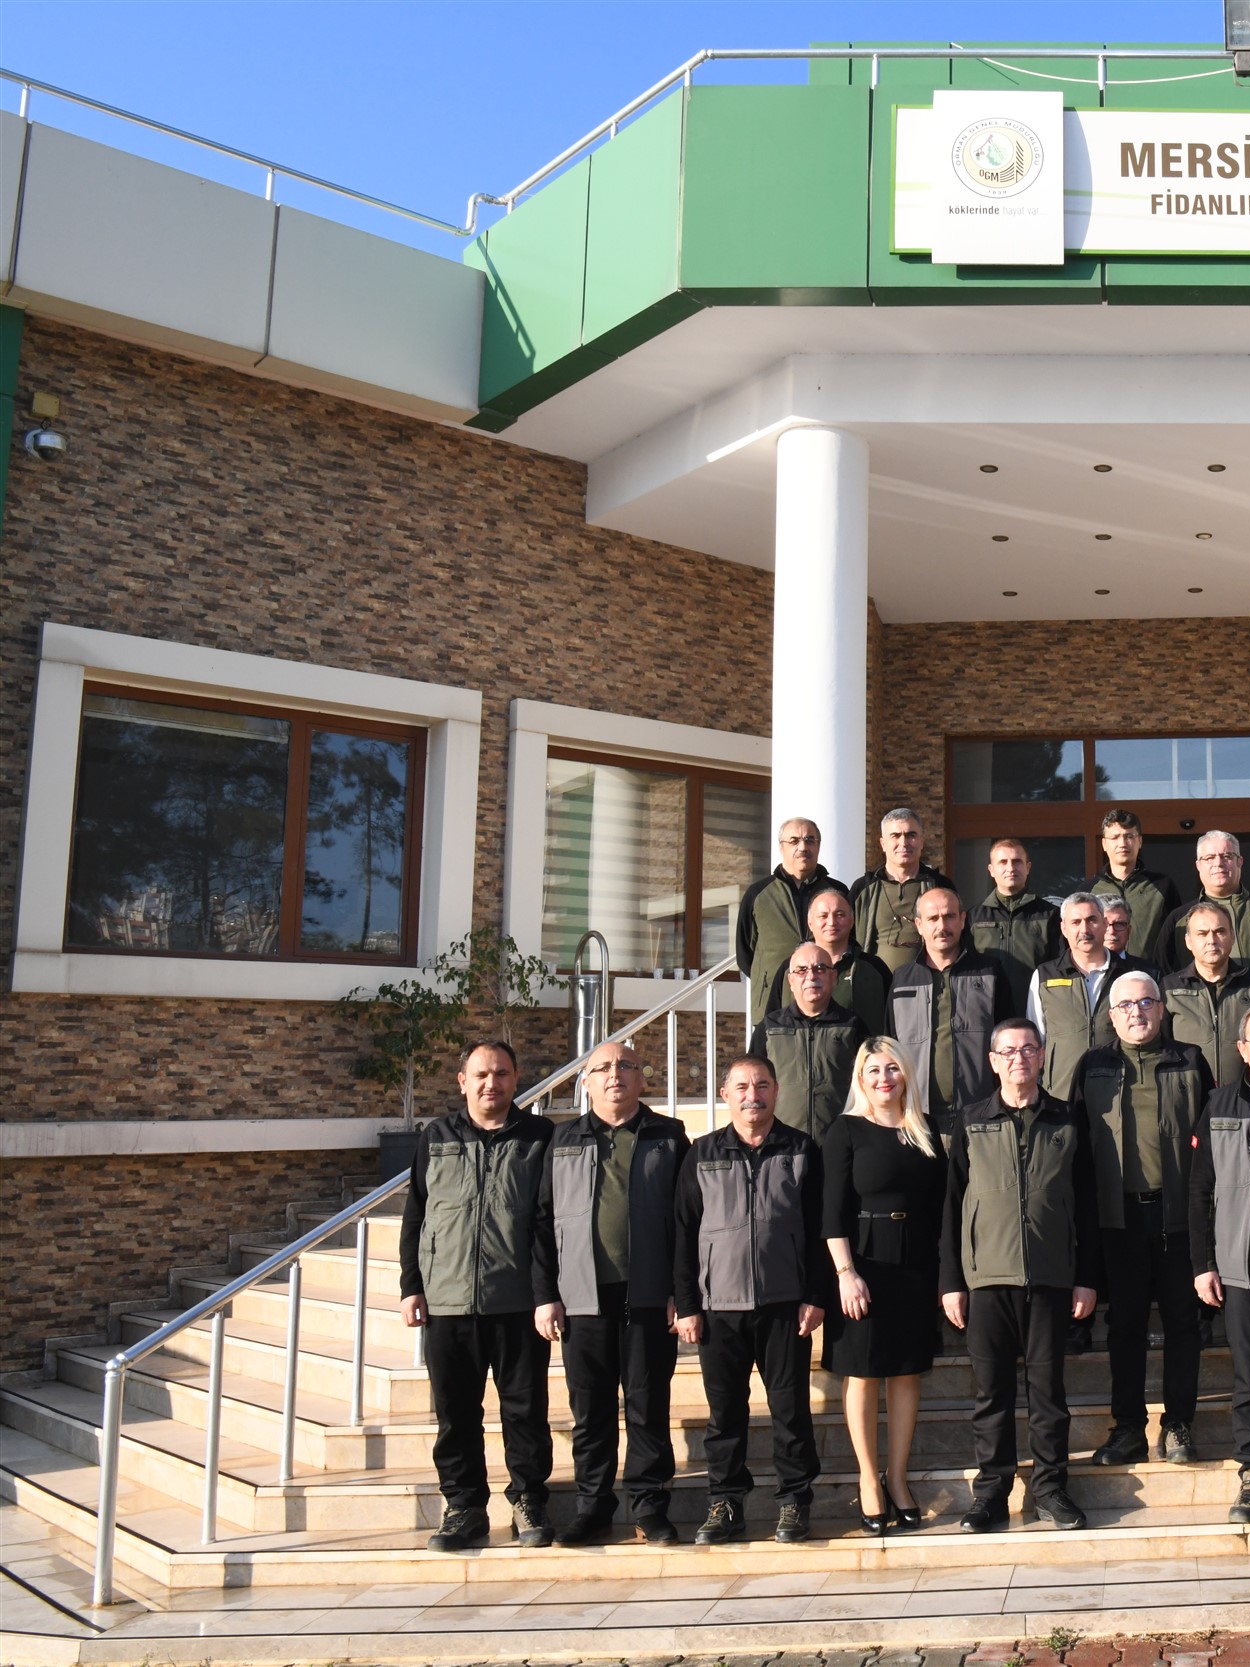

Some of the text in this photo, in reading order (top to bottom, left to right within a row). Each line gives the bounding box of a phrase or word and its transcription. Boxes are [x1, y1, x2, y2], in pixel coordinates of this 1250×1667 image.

[955, 135, 968, 167] ORMAN
[979, 168, 999, 182] OGM
[948, 204, 1000, 215] köklerinde
[1003, 205, 1025, 217] hayat
